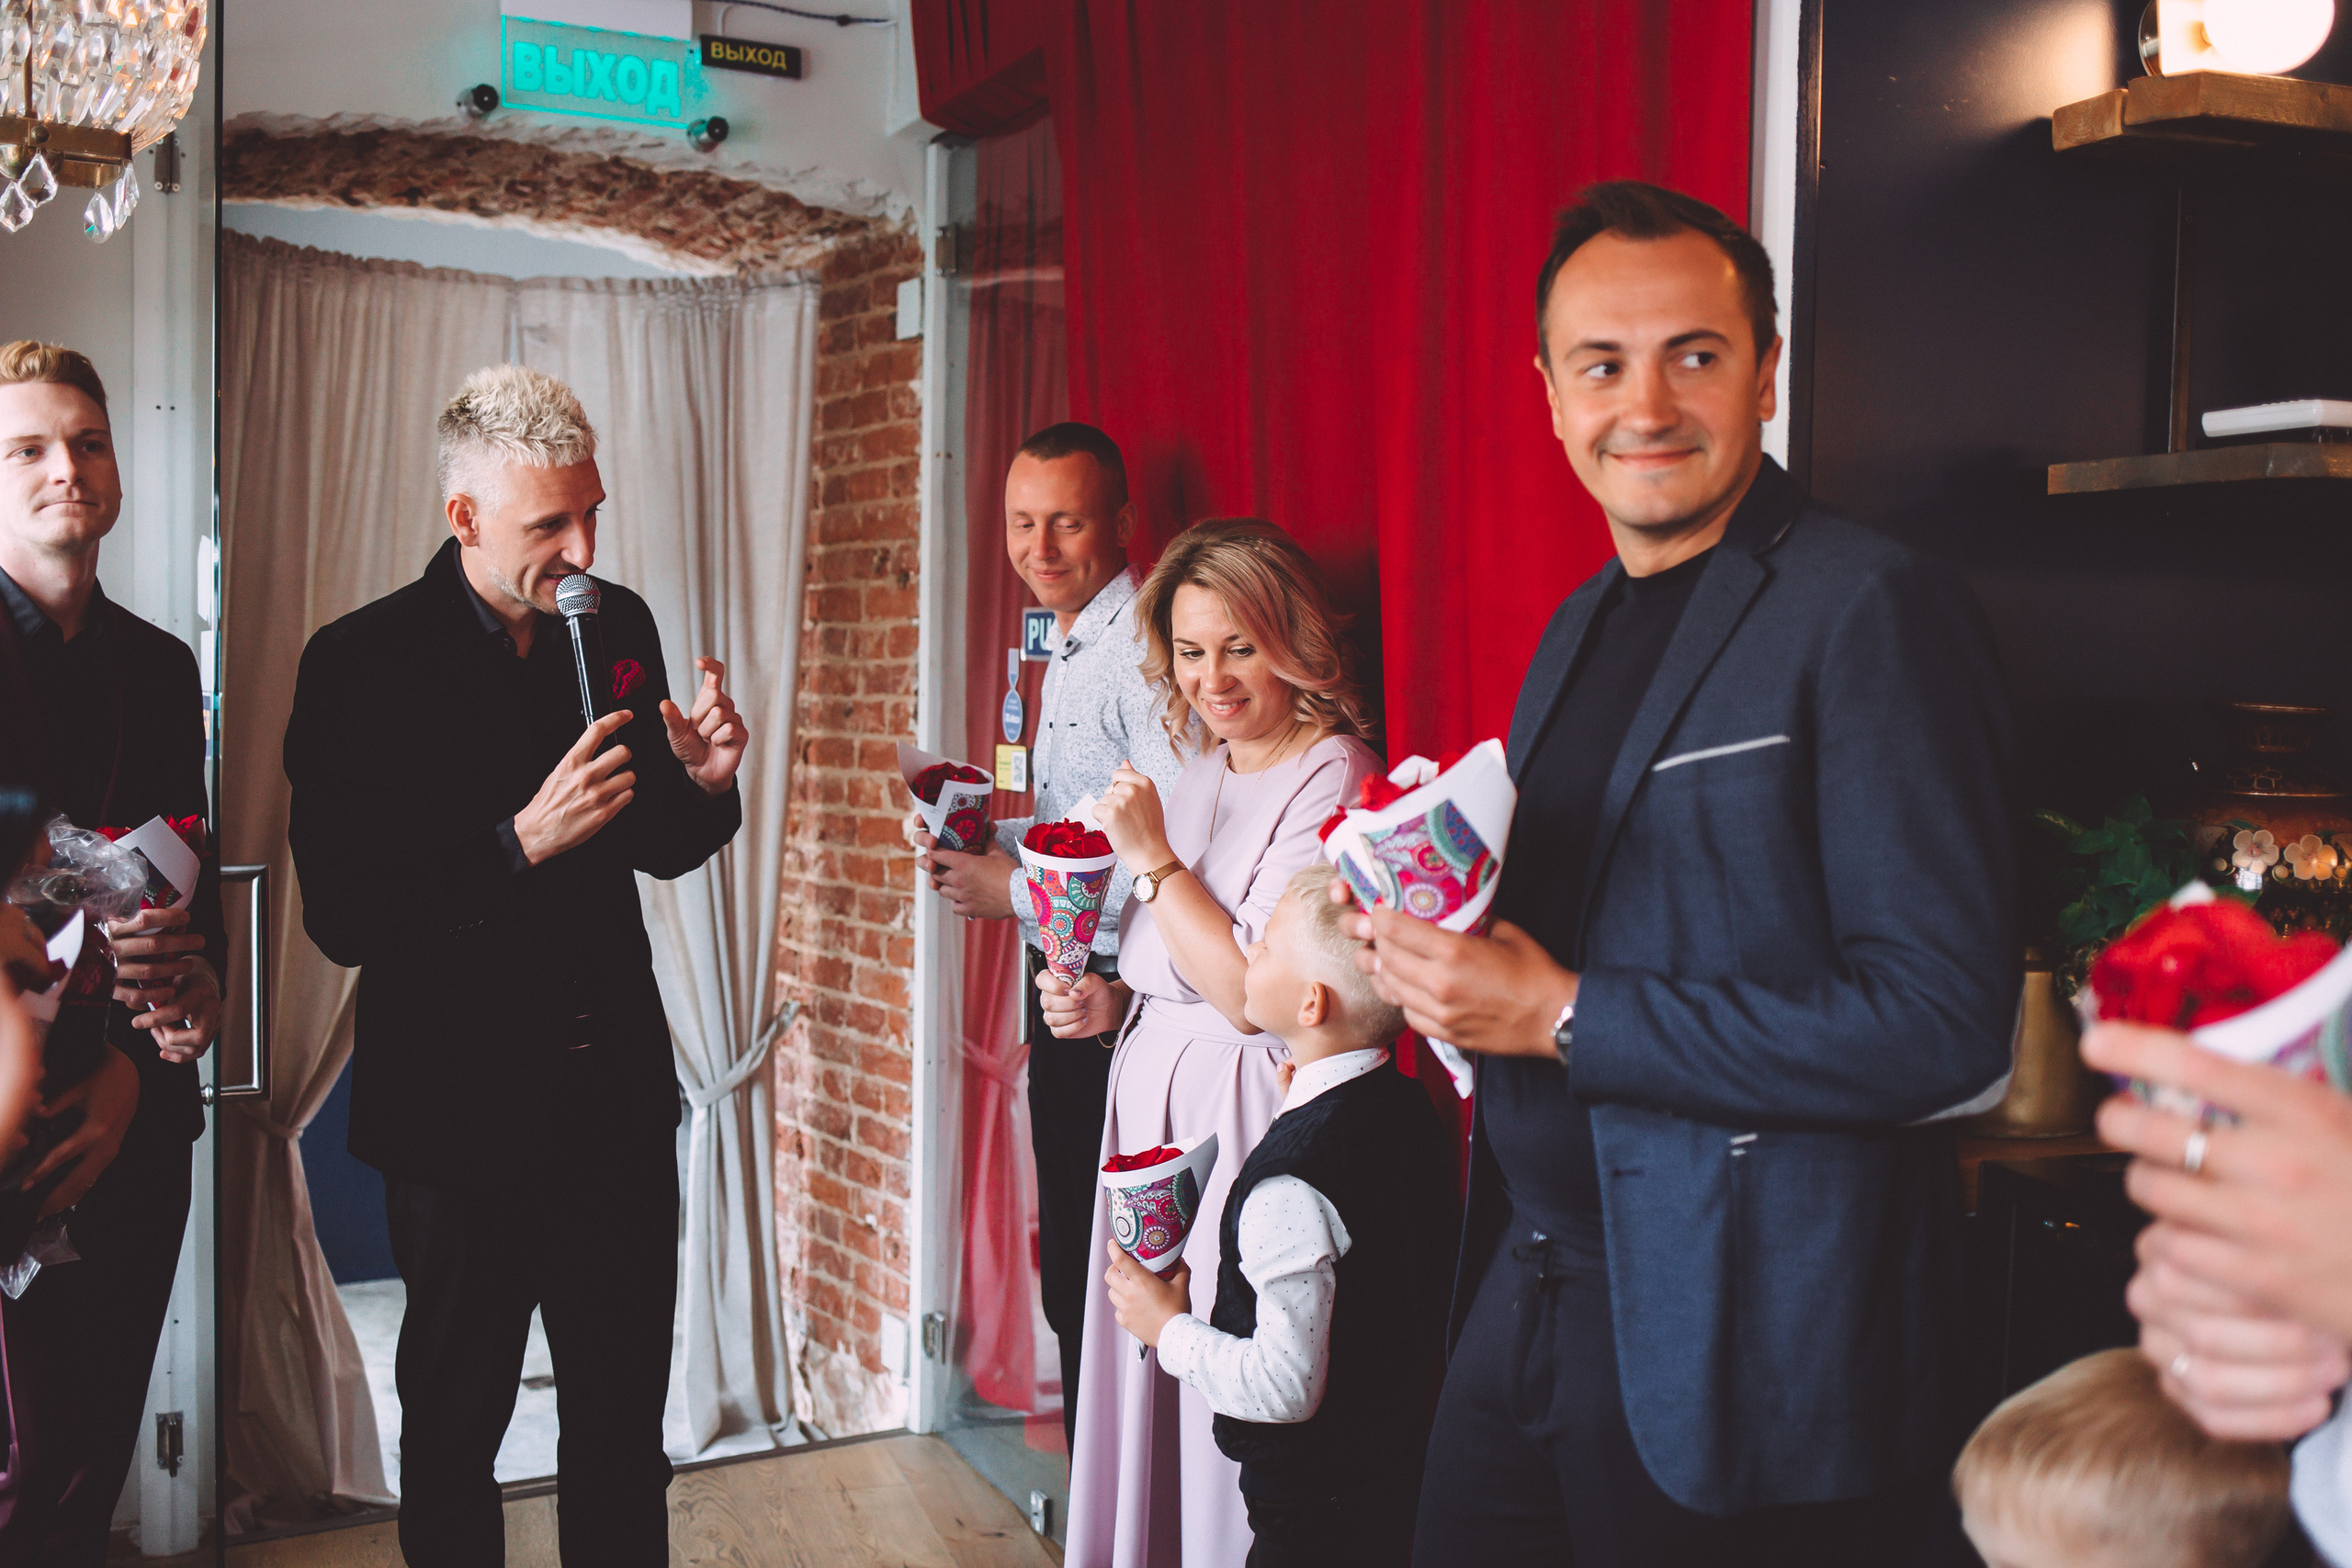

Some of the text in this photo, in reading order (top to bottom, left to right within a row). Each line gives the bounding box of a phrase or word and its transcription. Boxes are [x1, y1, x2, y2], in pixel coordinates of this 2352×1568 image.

[710, 40, 787, 71] ВЫХОД
[513, 40, 682, 118] ВЫХОД
[1027, 617, 1053, 651] PU
